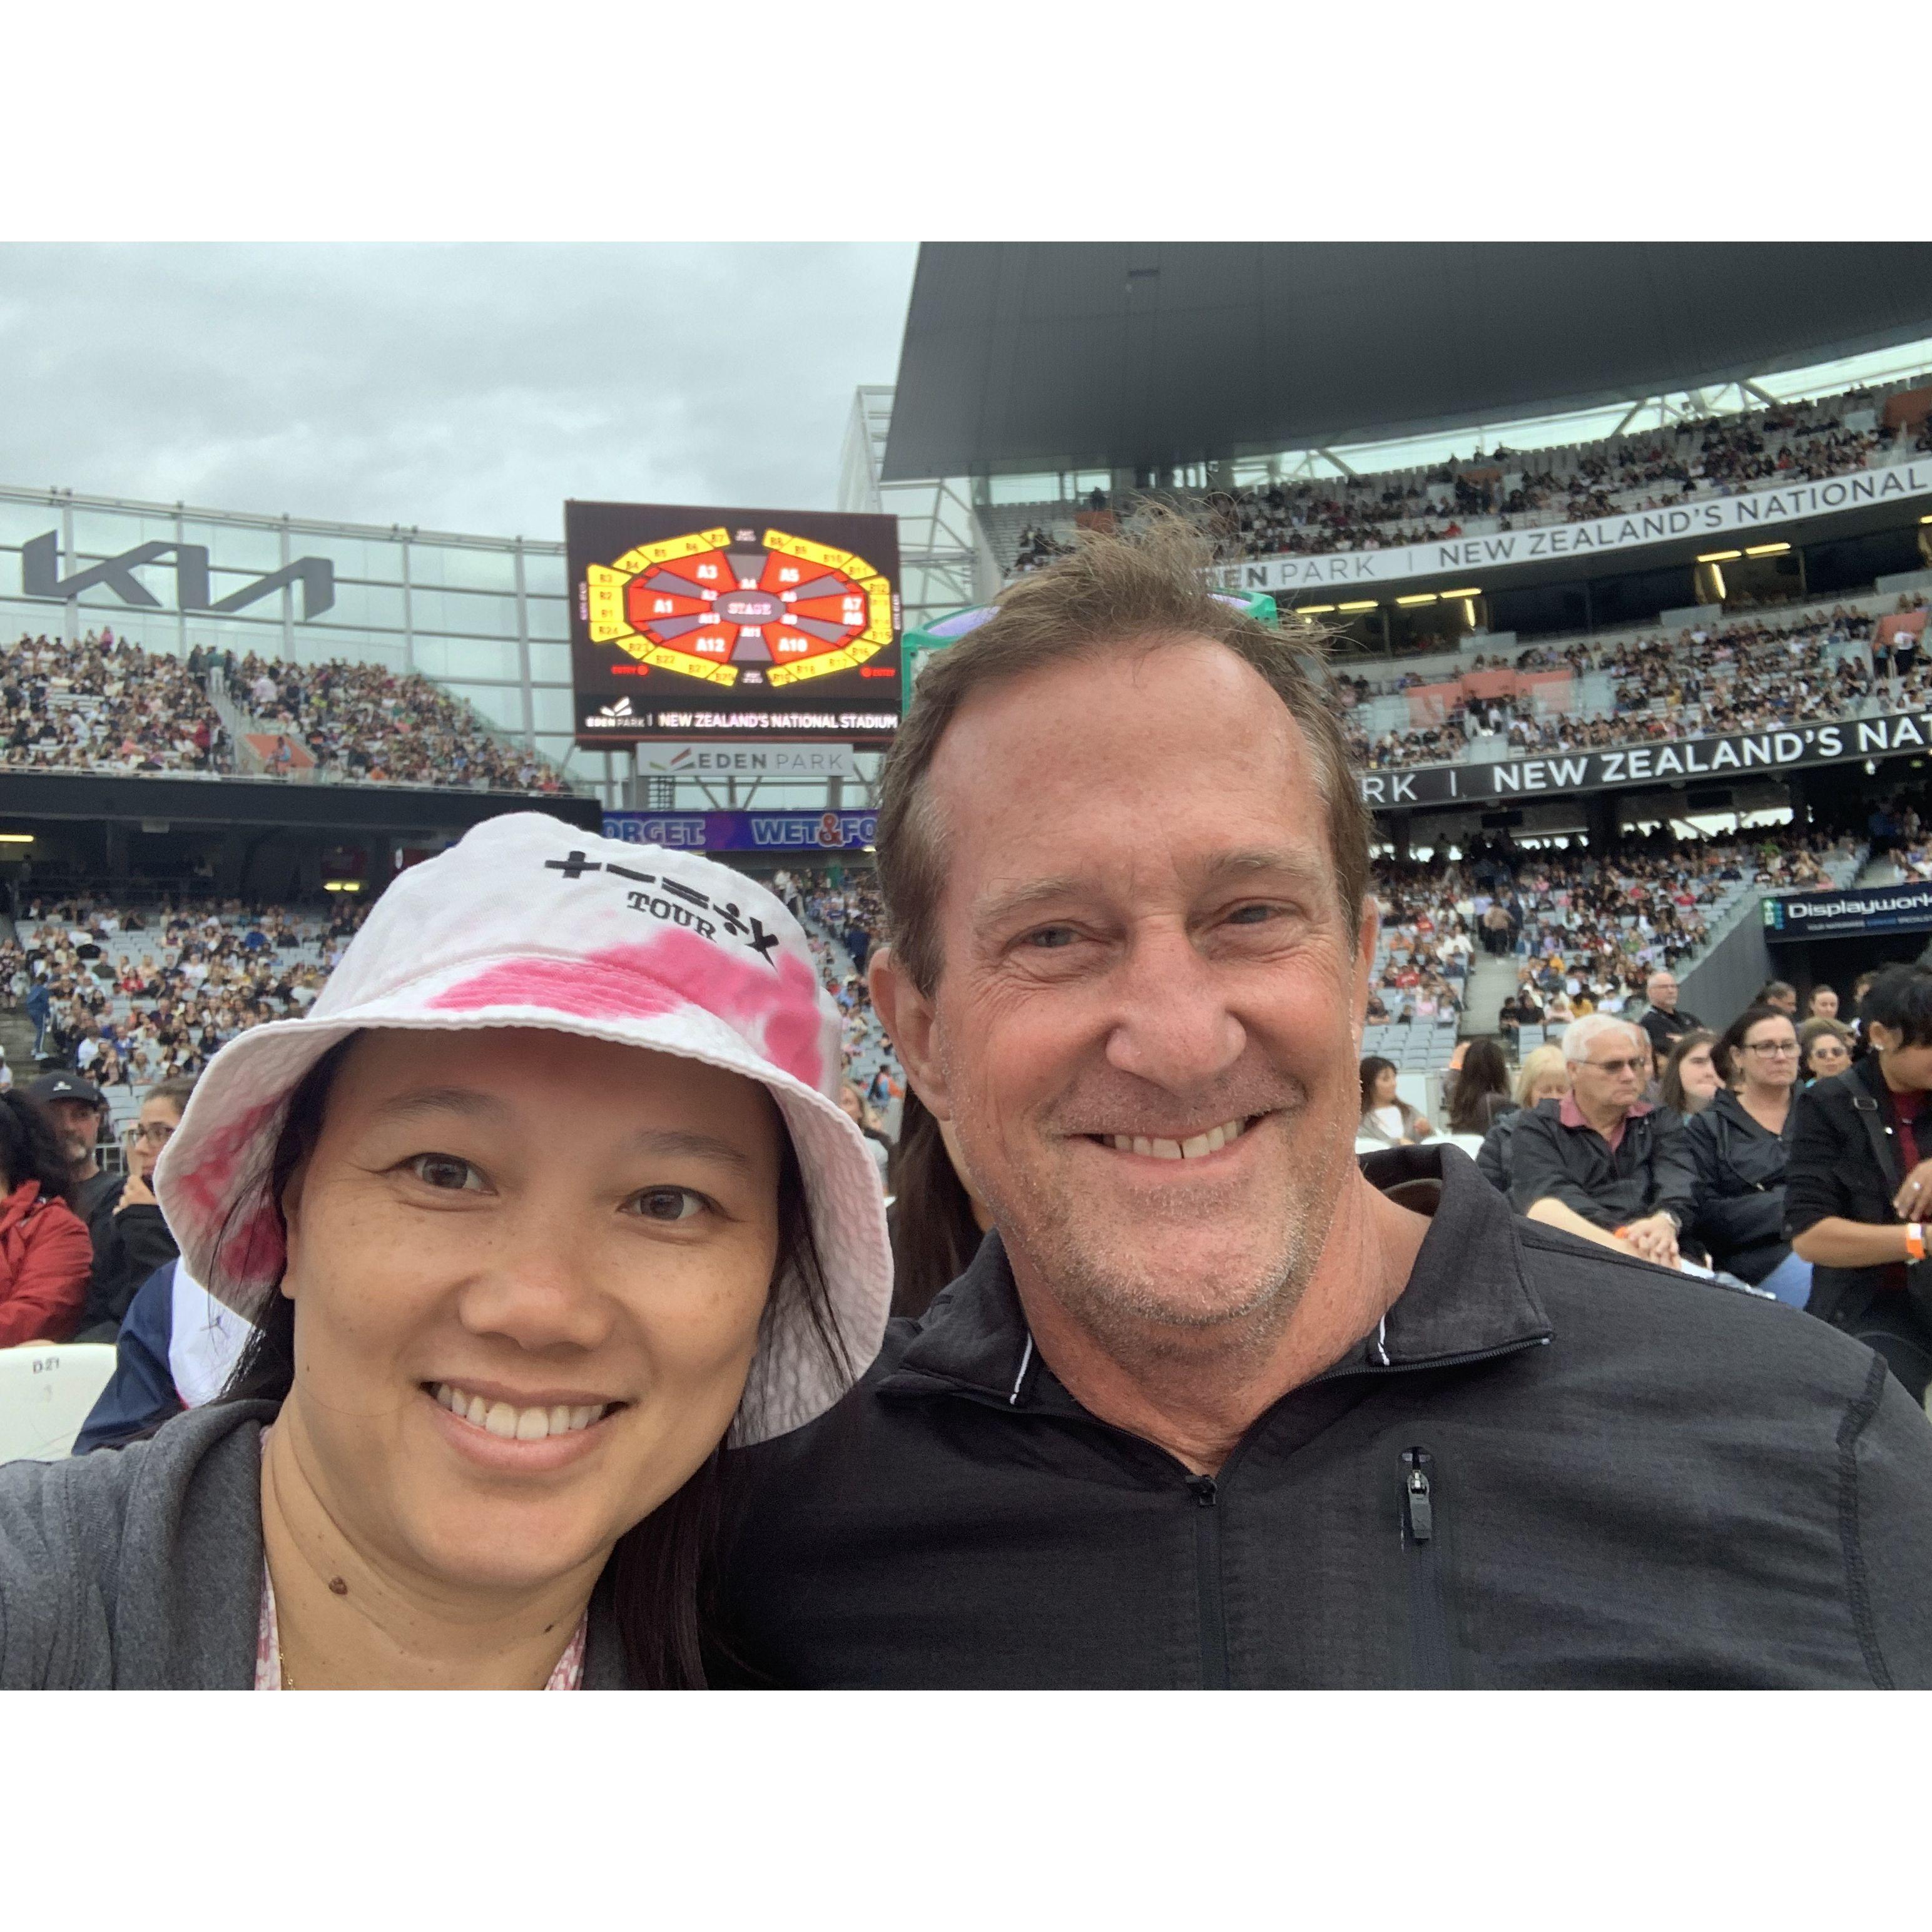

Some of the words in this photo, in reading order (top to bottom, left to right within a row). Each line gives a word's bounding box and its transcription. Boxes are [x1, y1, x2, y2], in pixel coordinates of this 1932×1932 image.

[1280, 555, 1376, 585] PARK
[1440, 537, 1516, 567] NEW
[1529, 506, 1722, 555] ZEALAND'S
[1737, 468, 1929, 522] NATIONAL
[697, 564, 719, 579] A3
[779, 567, 800, 582] A5
[653, 598, 674, 614] A1
[727, 602, 773, 616] STAGE
[841, 597, 863, 611] A7
[695, 637, 726, 653] A12
[777, 637, 808, 653] A10
[585, 716, 616, 728] EDEN
[617, 718, 645, 728] PARK
[658, 712, 693, 728] NEW
[694, 712, 770, 728] ZEALAND'S
[771, 713, 839, 729] NATIONAL
[840, 713, 898, 729] STADIUM
[698, 753, 766, 770] EDEN
[776, 753, 843, 770] PARK
[1492, 756, 1588, 793] NEW
[1602, 726, 1843, 783] ZEALAND'S
[627, 891, 717, 943] TOUR
